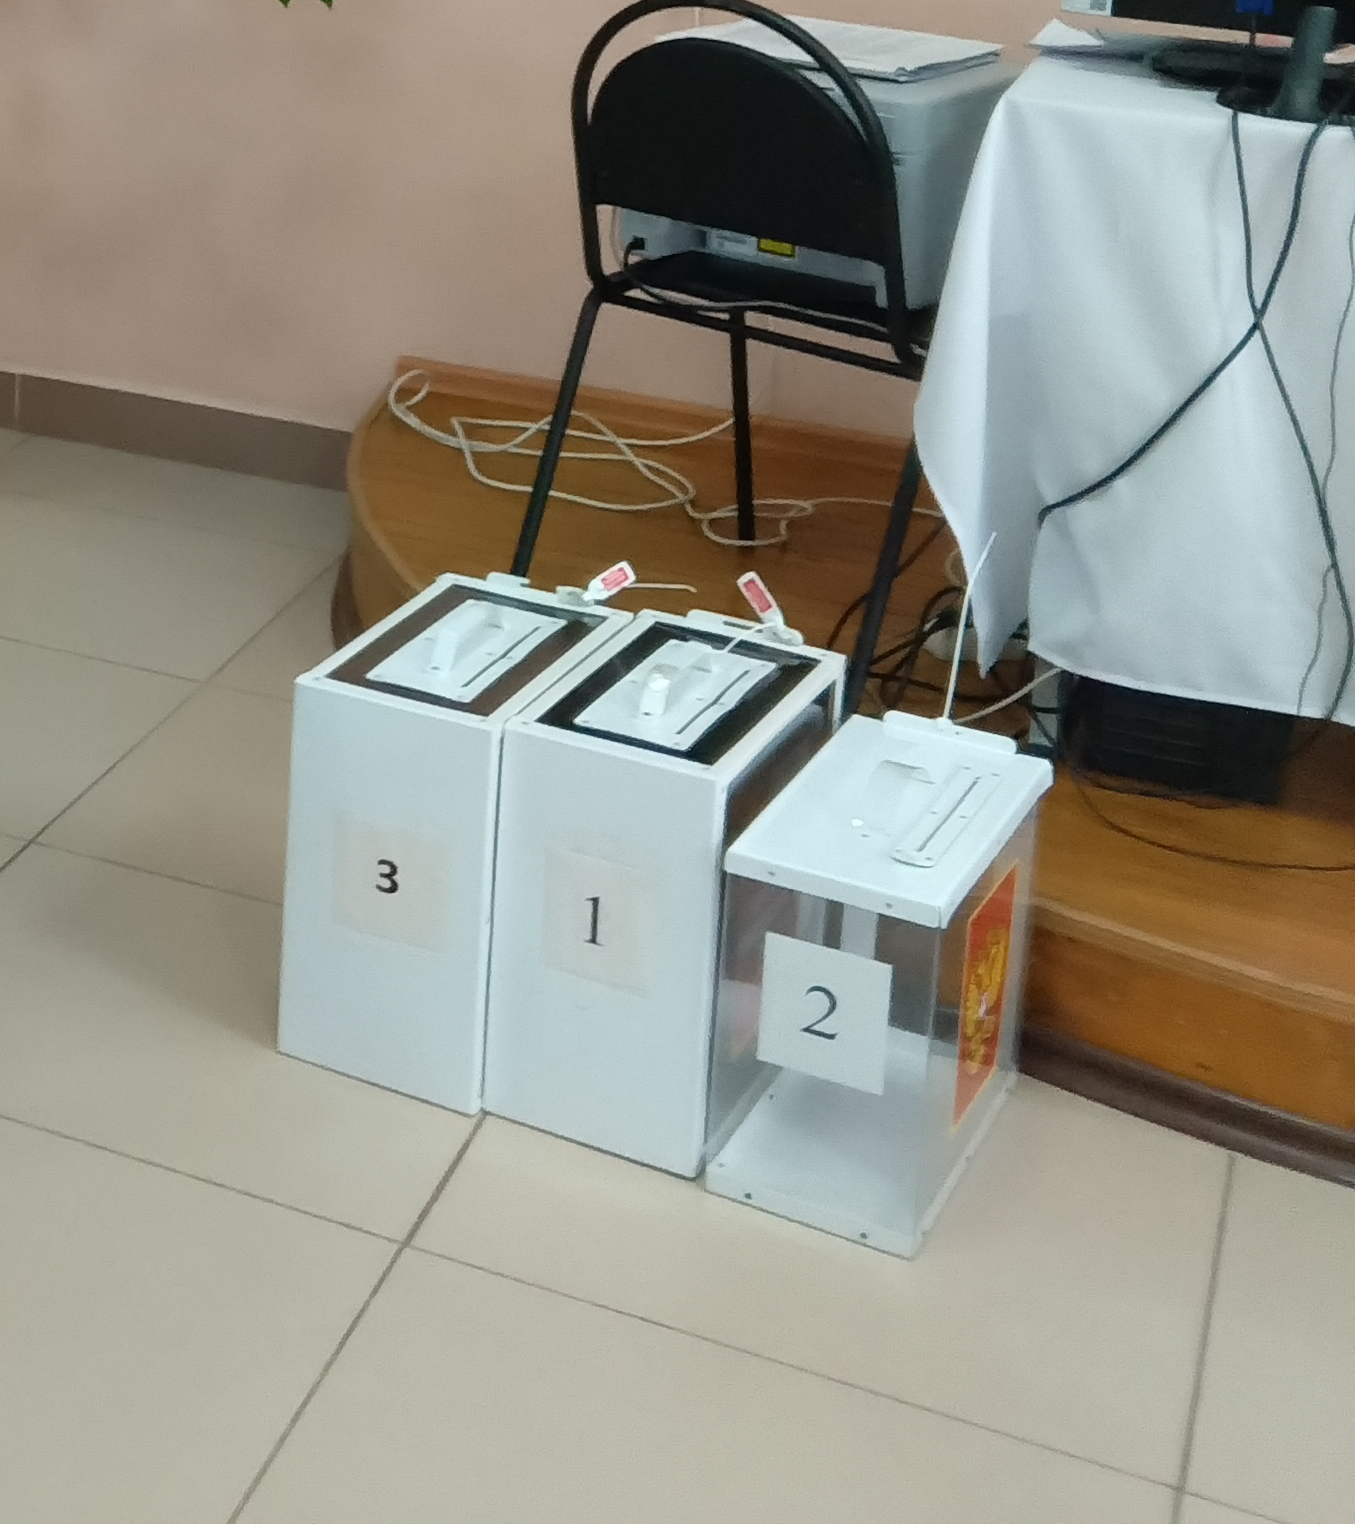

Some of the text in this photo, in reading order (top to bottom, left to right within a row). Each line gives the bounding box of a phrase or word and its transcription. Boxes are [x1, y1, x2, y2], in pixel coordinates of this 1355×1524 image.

[374, 858, 401, 894] 3
[583, 895, 605, 947] 1
[799, 984, 840, 1041] 2
